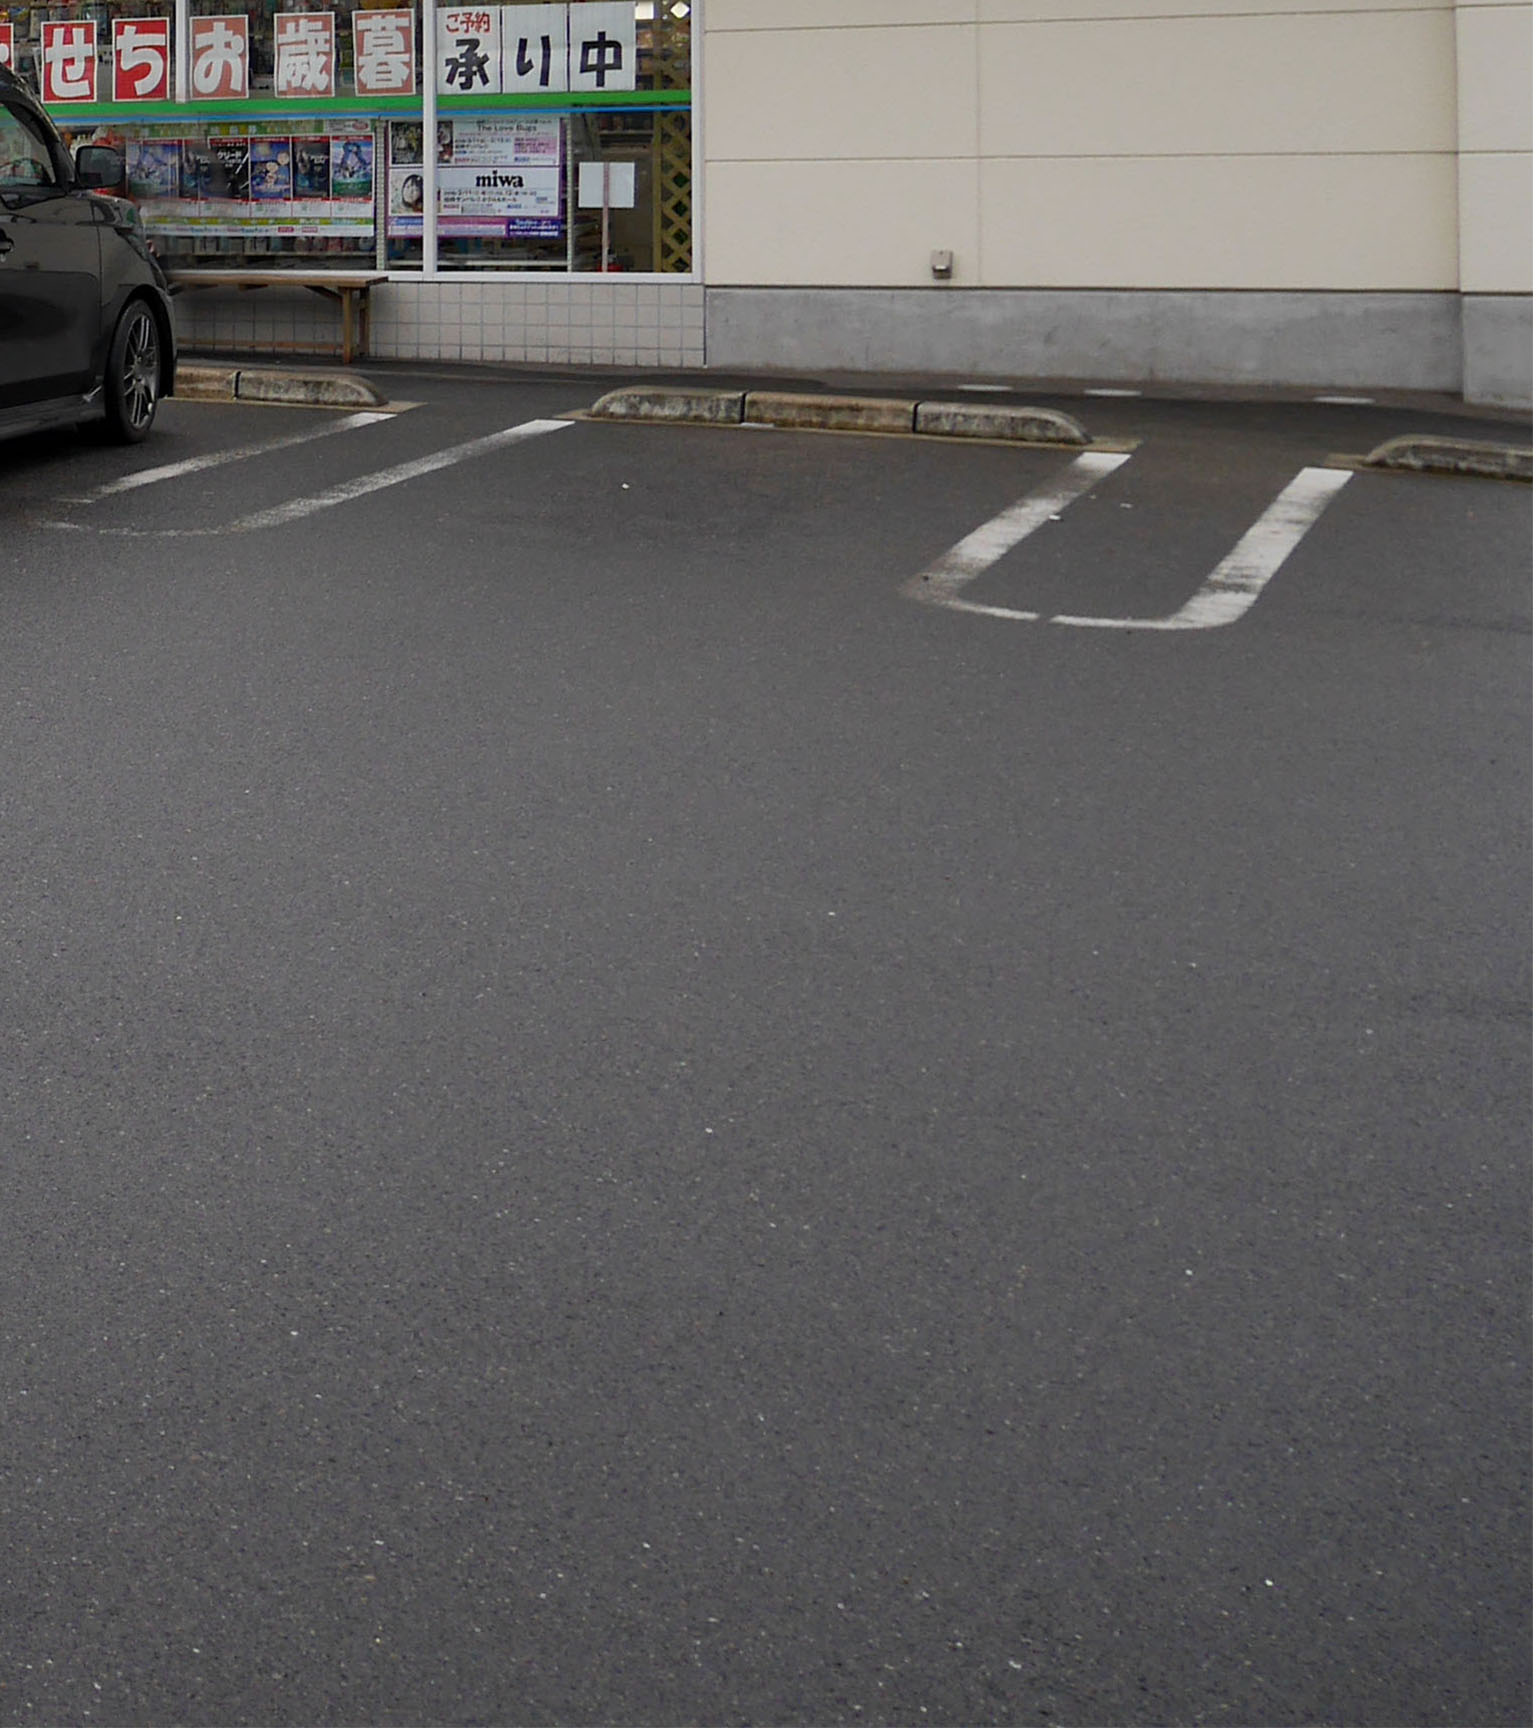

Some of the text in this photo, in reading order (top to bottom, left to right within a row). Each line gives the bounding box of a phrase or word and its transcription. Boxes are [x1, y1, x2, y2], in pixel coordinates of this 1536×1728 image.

[445, 11, 491, 35] ご予約
[444, 30, 623, 90] 承り中
[475, 169, 524, 188] miwa
